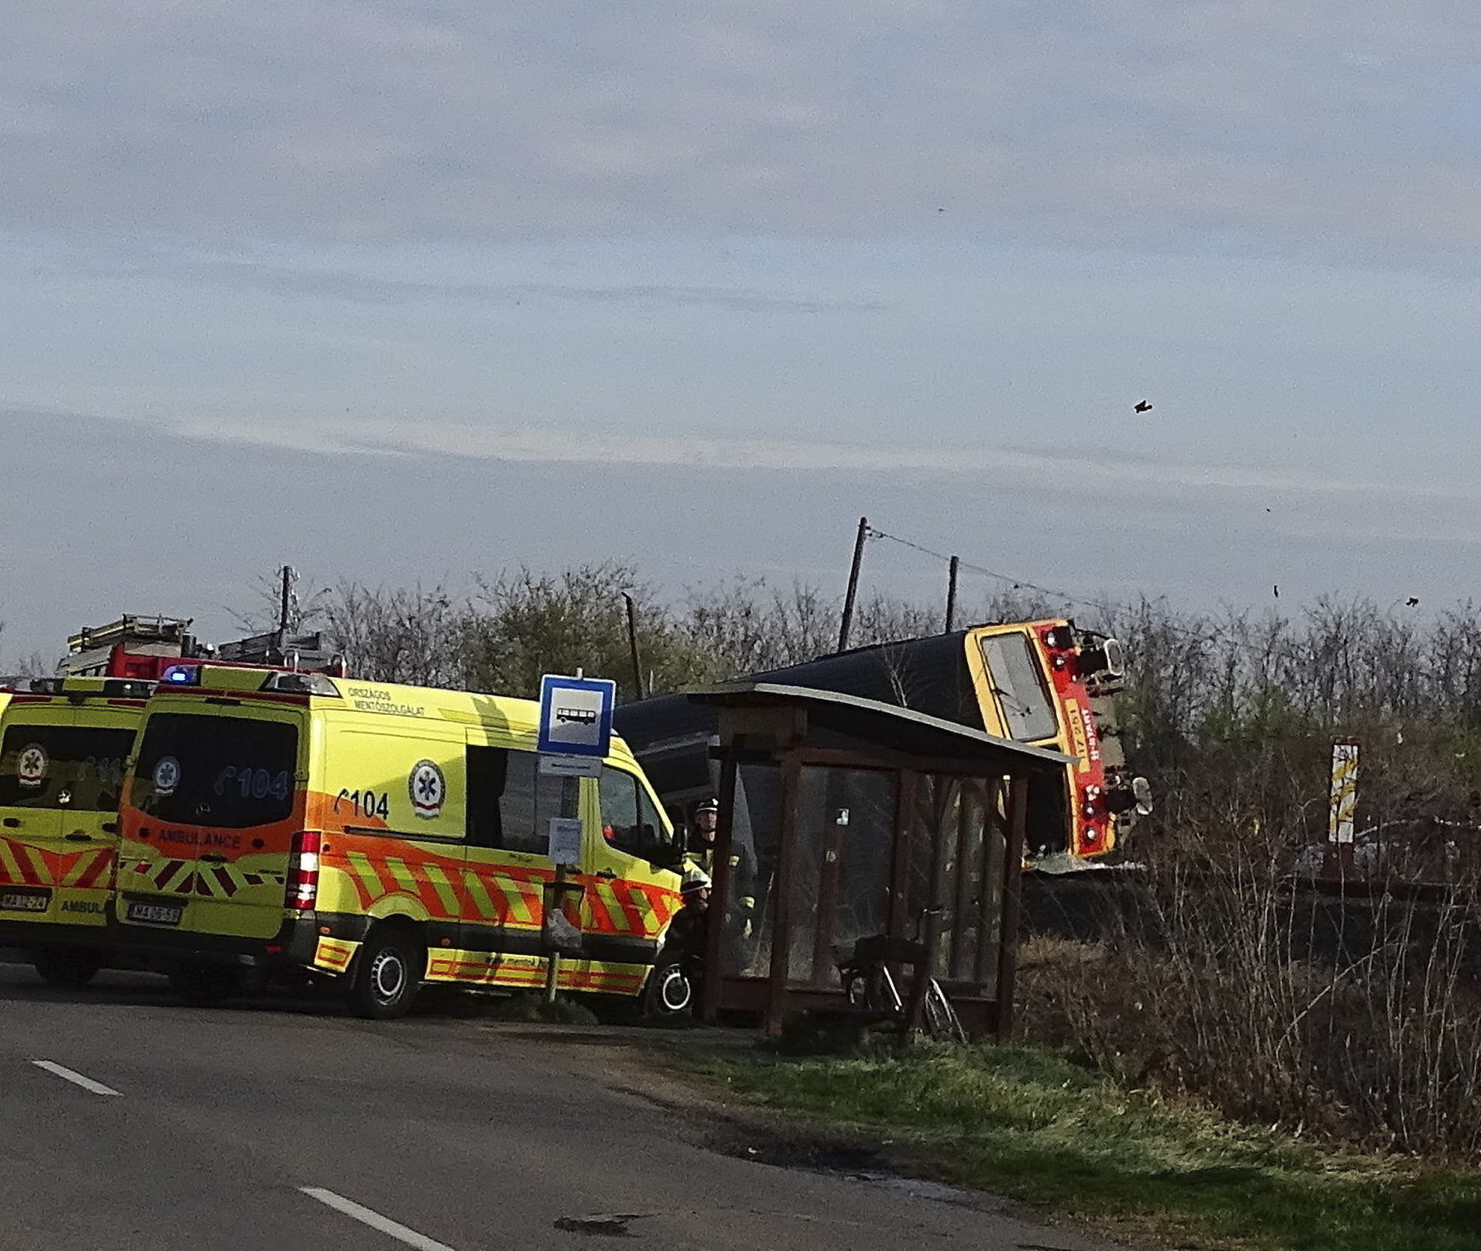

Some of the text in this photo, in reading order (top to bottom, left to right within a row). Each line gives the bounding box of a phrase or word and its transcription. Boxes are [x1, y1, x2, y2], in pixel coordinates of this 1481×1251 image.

[348, 688, 391, 701] ORSZÁGOS
[354, 699, 424, 716] MENTŐSZOLGÁLAT
[239, 768, 288, 800] 104
[350, 789, 389, 820] 104
[159, 829, 241, 848] AMBULANCE
[61, 900, 106, 915] AMBUL
